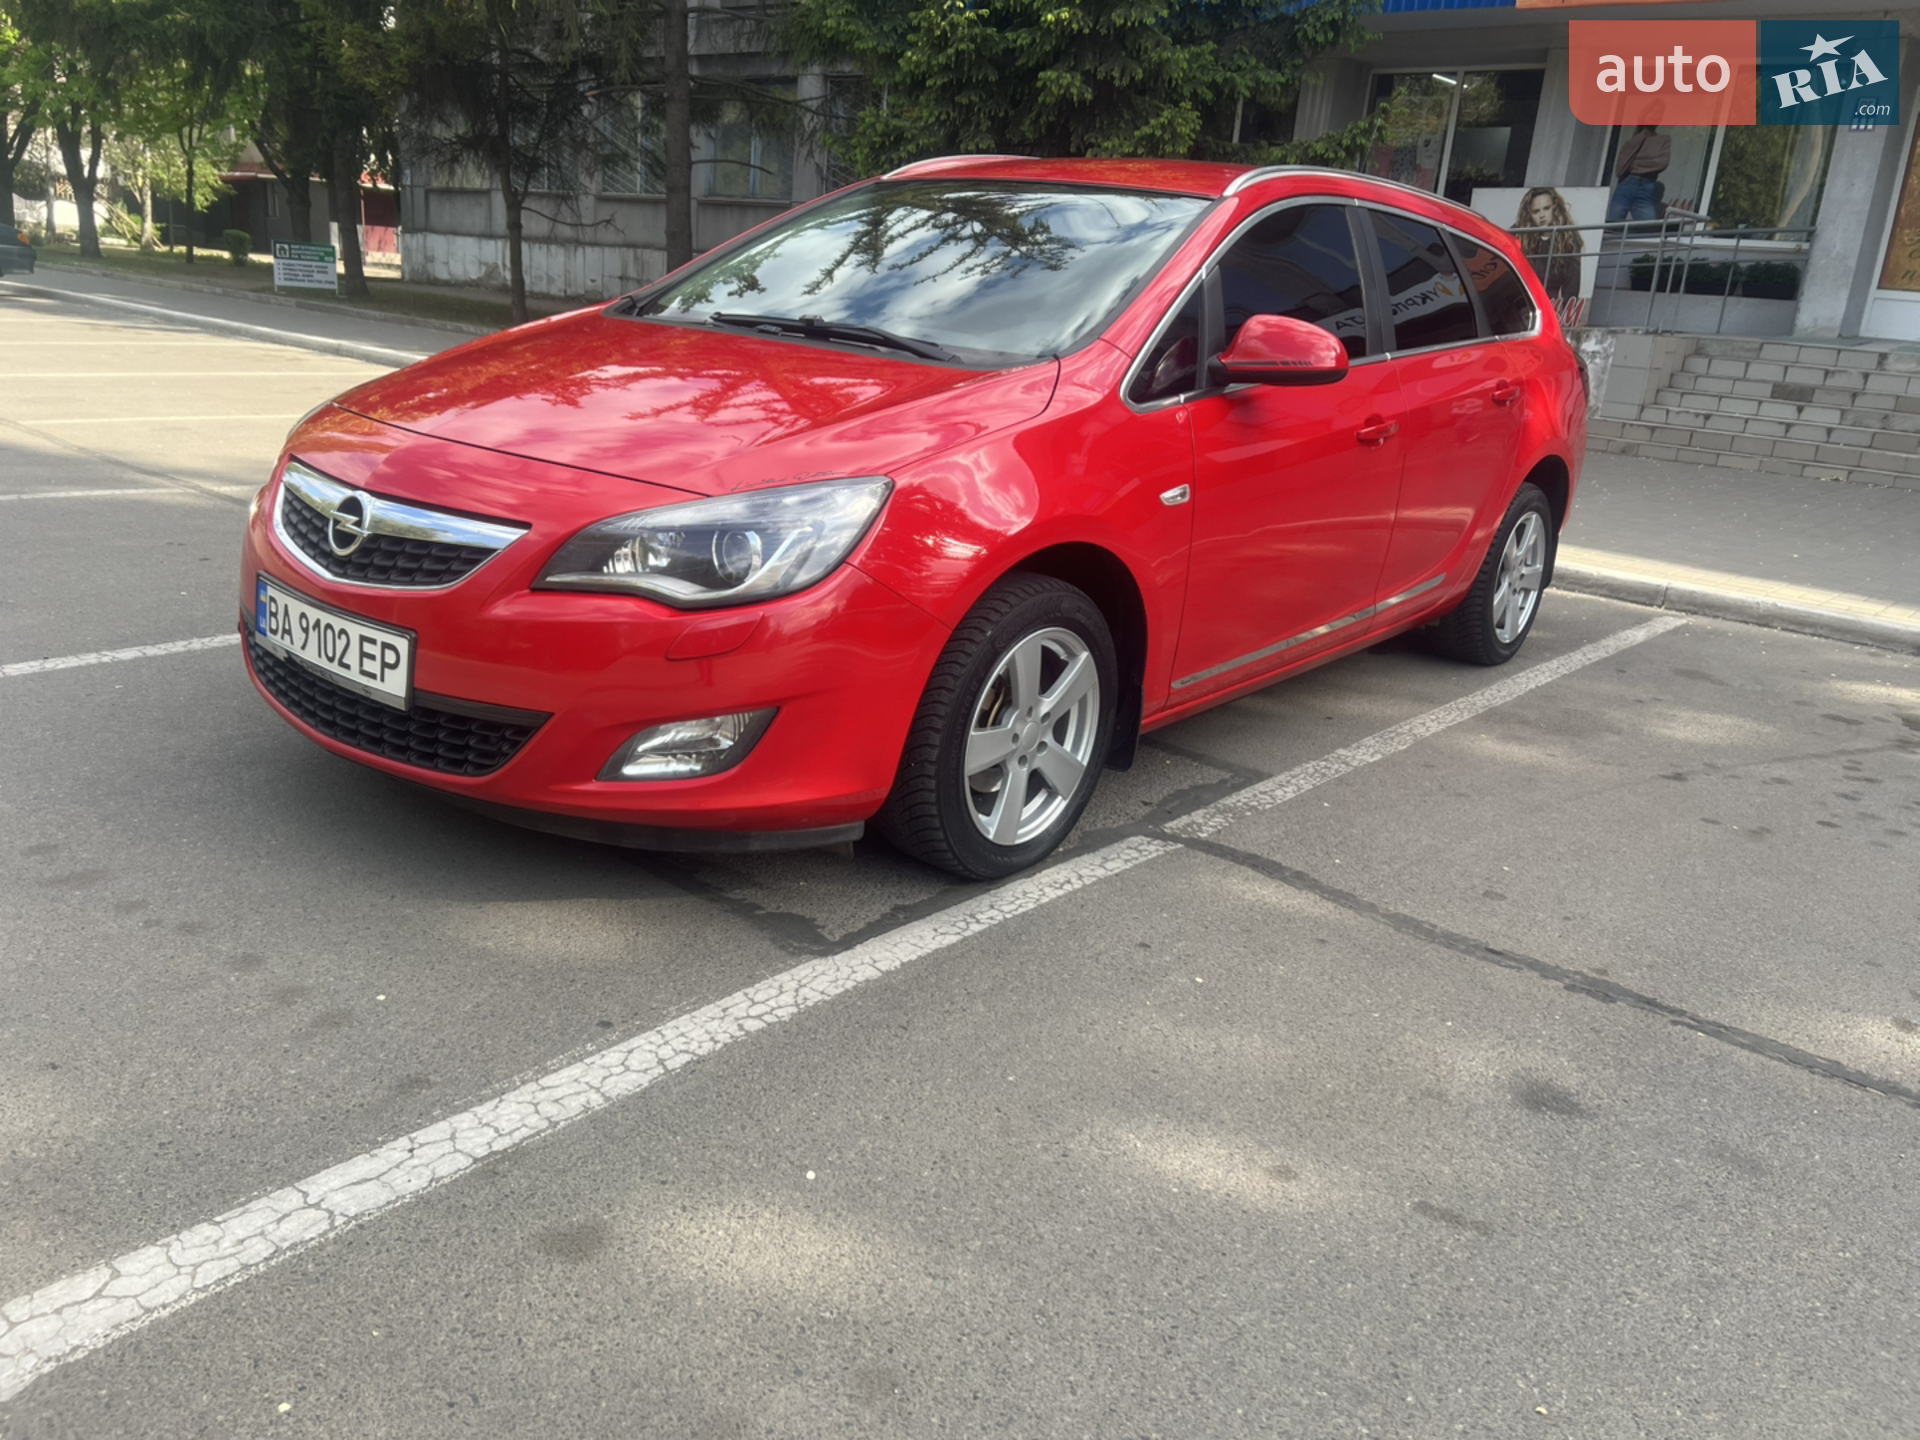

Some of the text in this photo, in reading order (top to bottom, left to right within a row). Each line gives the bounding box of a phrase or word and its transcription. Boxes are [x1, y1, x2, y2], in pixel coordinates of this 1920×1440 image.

[268, 594, 401, 683] BA 9102 EP
